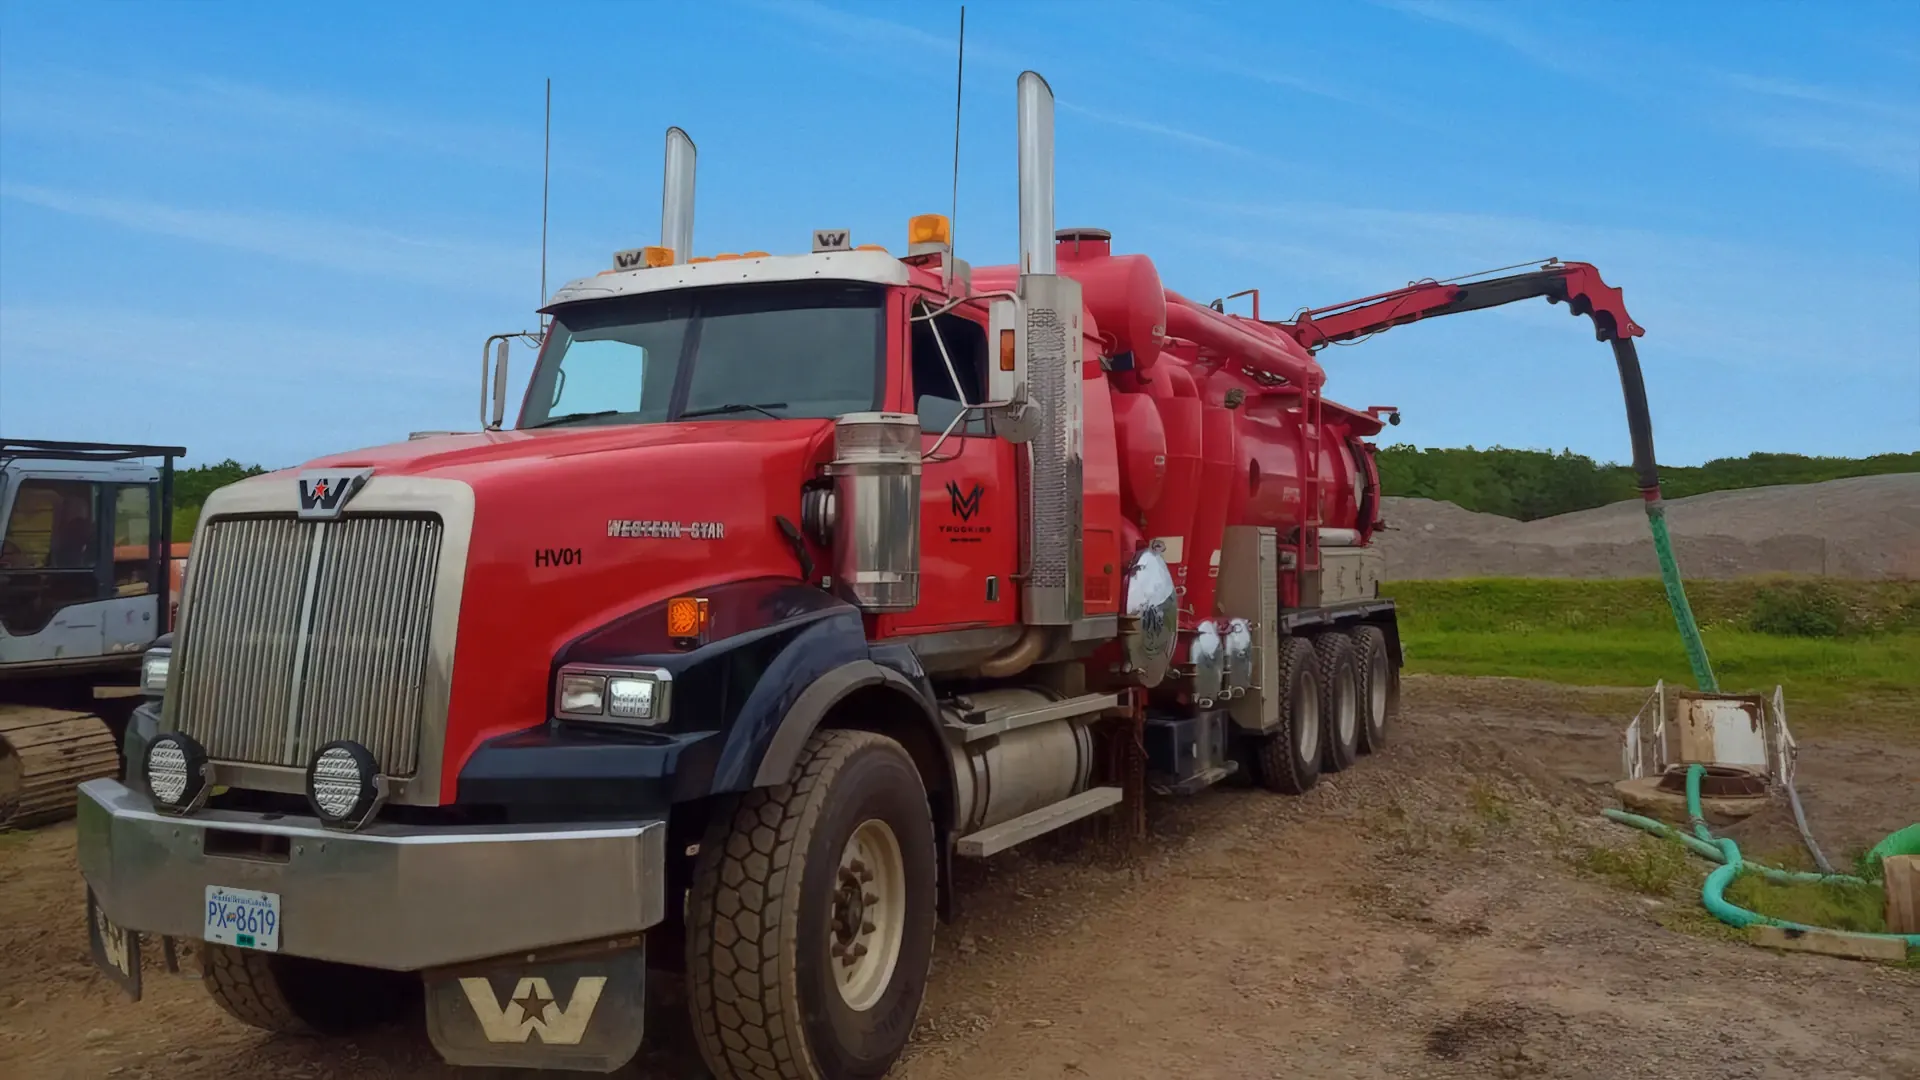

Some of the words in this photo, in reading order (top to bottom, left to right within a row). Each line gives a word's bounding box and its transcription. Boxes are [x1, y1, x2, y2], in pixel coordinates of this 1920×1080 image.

[607, 519, 681, 538] WESTERN
[691, 521, 724, 539] STAR
[535, 547, 582, 568] HV01
[236, 905, 276, 936] 8619
